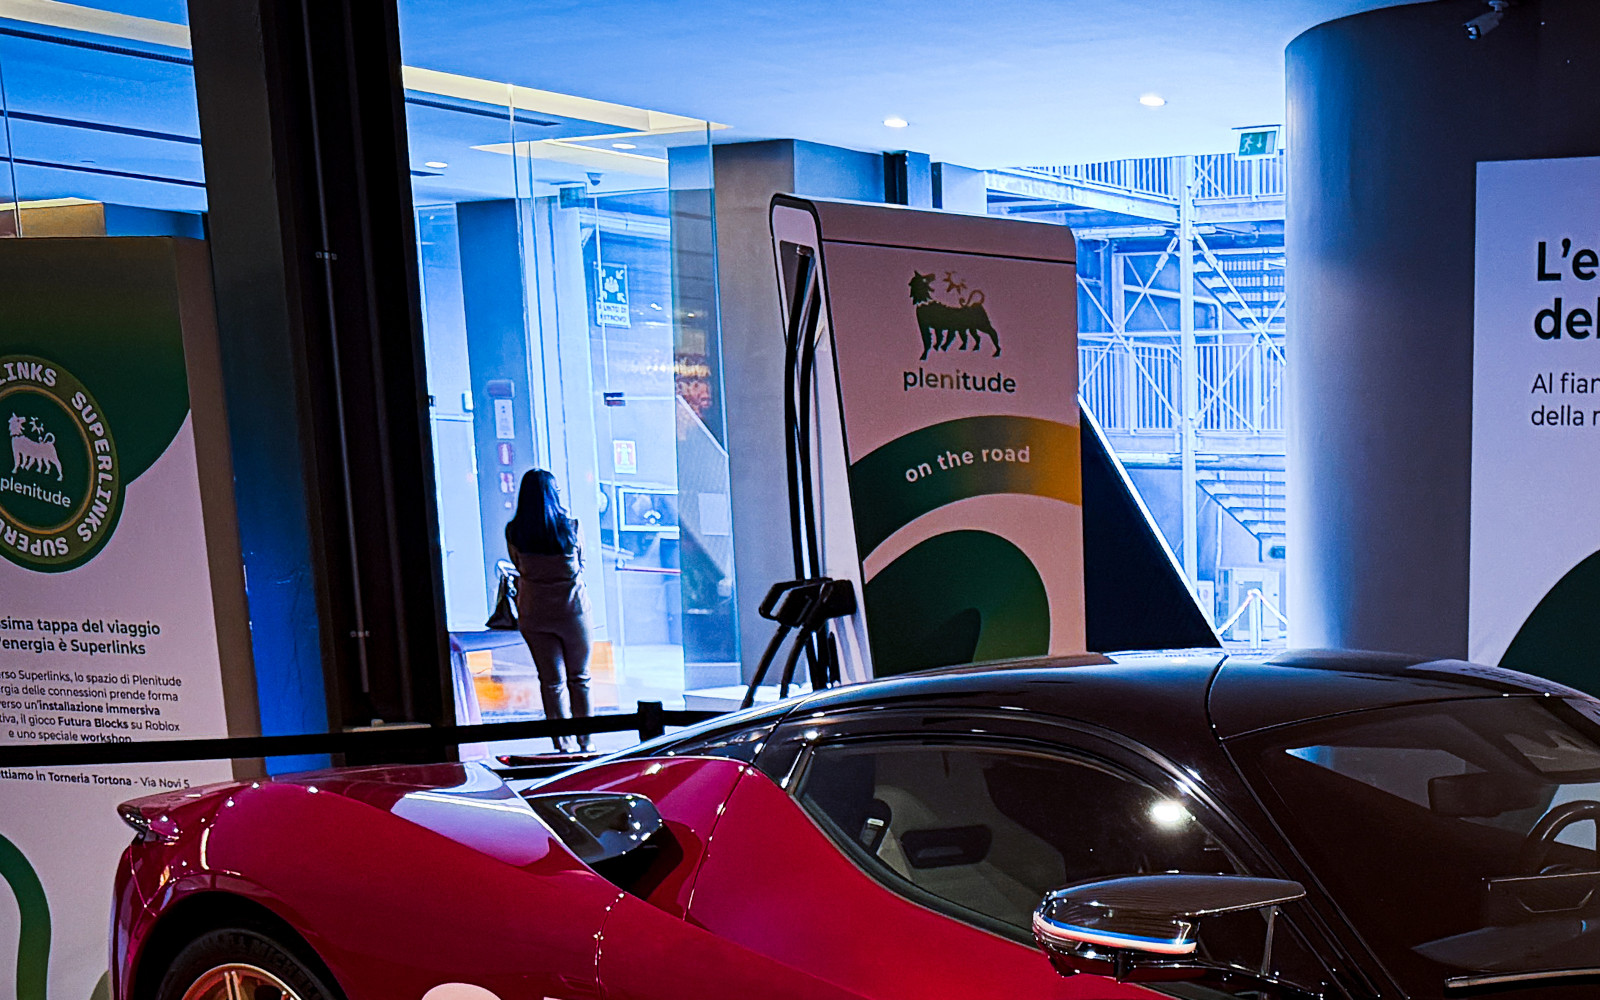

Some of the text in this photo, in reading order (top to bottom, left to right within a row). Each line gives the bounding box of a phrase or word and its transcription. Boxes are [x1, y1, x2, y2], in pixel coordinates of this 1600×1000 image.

[904, 367, 1015, 392] plenitude
[1532, 373, 1552, 393] Al
[1532, 405, 1583, 426] della
[71, 391, 113, 542] SUPERLINKS
[906, 446, 1029, 481] on the road
[0, 476, 71, 508] plenitude
[38, 619, 160, 637] tappa del viaggio
[59, 638, 146, 656] è Superlinks
[18, 670, 182, 687] Superlinks, lo spazio di Plenitude
[22, 685, 178, 701] delle connessioni prende forma
[106, 703, 160, 715] immersiva
[21, 714, 26, 724] il
[29, 715, 56, 727] gioco
[58, 717, 92, 727] Futura
[94, 718, 129, 729] Blocks
[146, 721, 180, 731] Roblox
[9, 730, 78, 741] e uno speciale
[36, 771, 46, 781] in
[48, 772, 90, 783] Torneria
[92, 775, 132, 786] Tortona
[140, 777, 156, 787] Via
[159, 779, 181, 788] Novi
